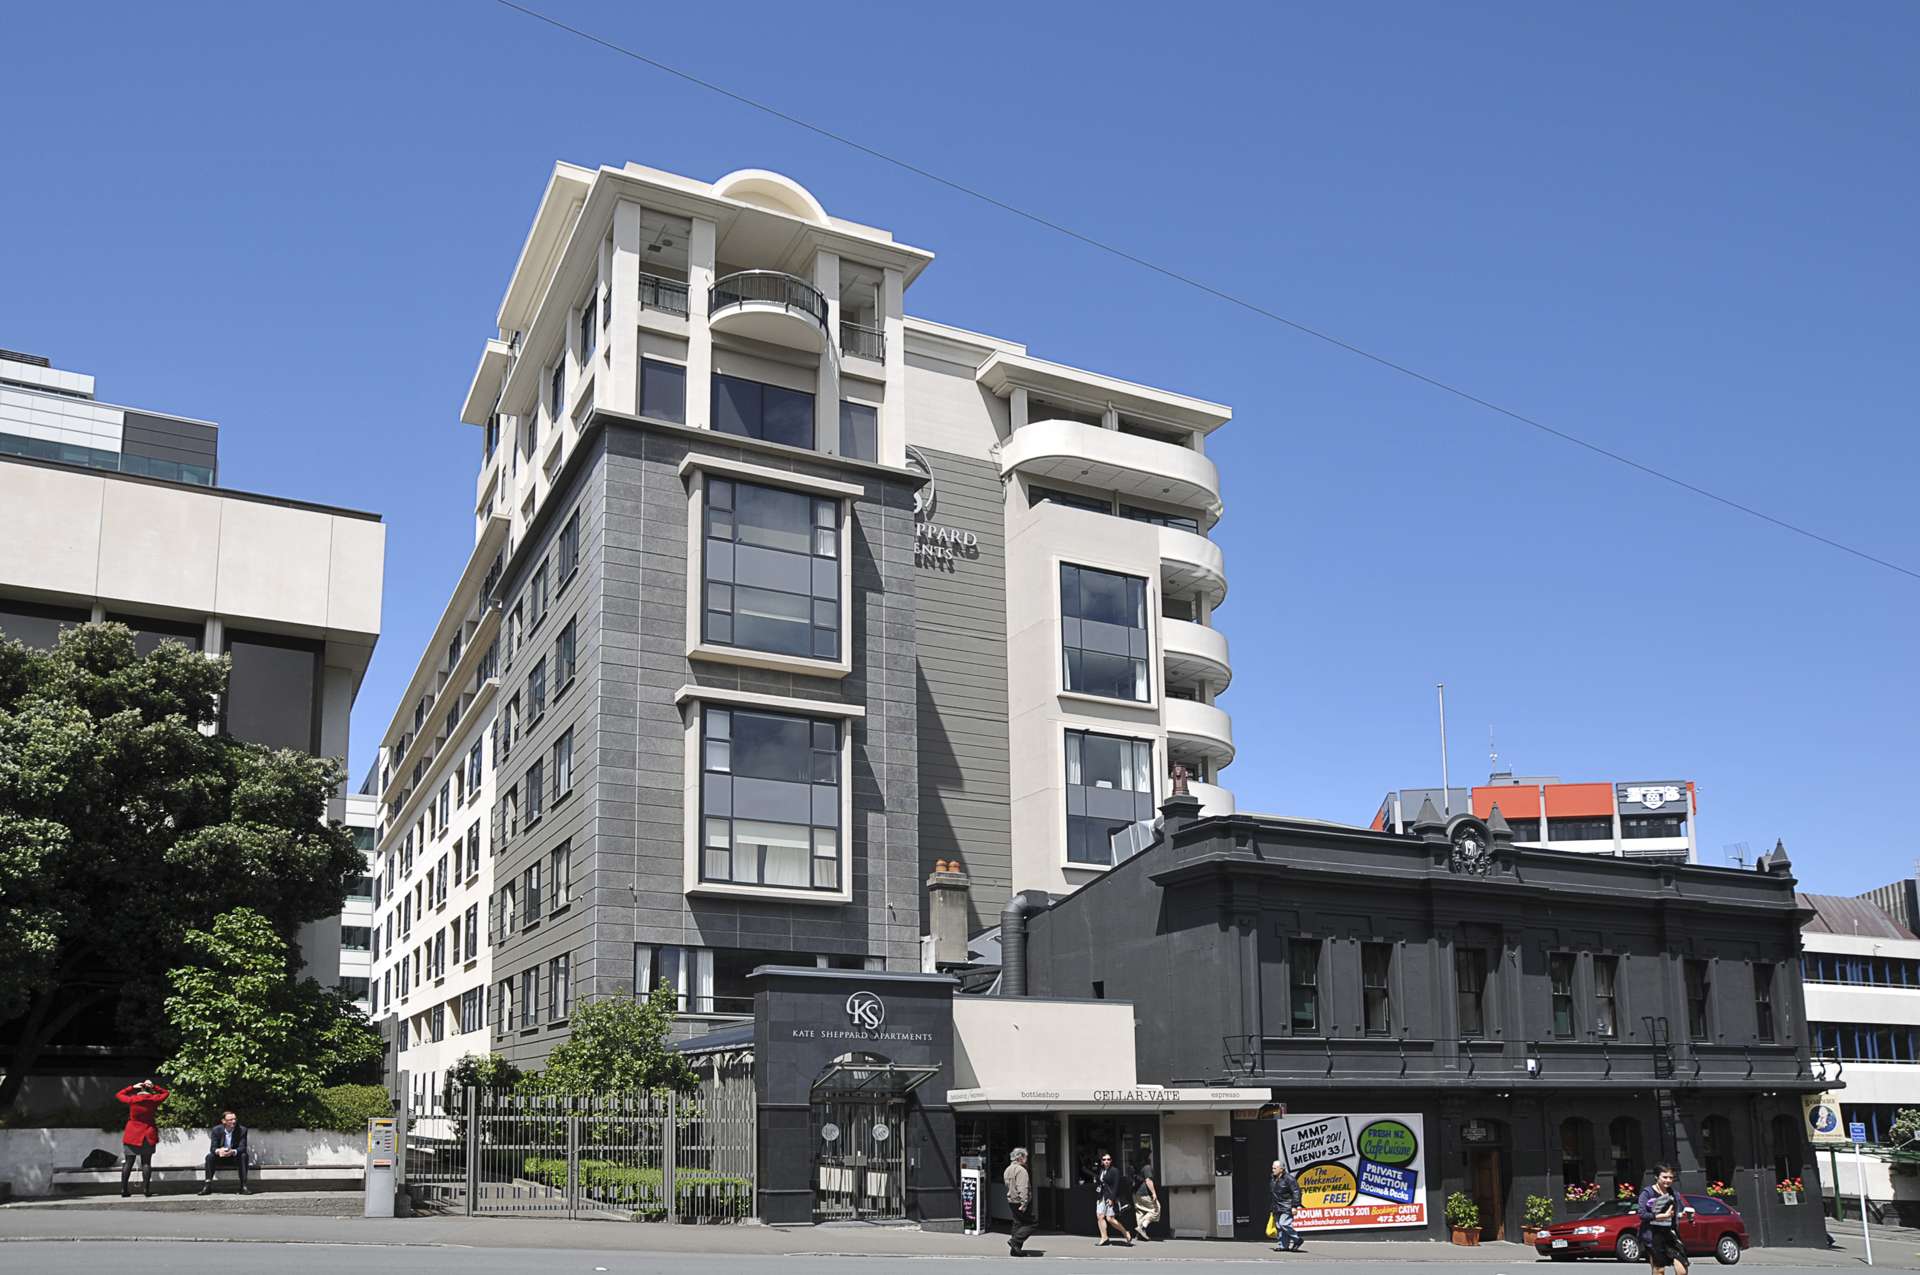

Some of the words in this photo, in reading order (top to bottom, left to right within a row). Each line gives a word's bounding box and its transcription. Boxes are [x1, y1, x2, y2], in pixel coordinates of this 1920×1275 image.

[792, 1029, 815, 1038] KATE
[821, 1030, 868, 1039] SHEPPARD
[873, 1031, 933, 1041] APARTMENTS
[1021, 1090, 1060, 1098] bottleshop
[1093, 1090, 1180, 1101] CELLAR-VATE
[1211, 1091, 1240, 1099] espresso
[1297, 1124, 1328, 1140] MMP
[1368, 1129, 1391, 1137] FRESH
[1394, 1130, 1405, 1138] NZ
[1290, 1136, 1325, 1154] ELECTION
[1326, 1131, 1342, 1144] 2011
[1366, 1163, 1403, 1180] PRIVATE
[1362, 1172, 1408, 1191] FUNCTION
[1323, 1192, 1351, 1204] FREE!
[1294, 1208, 1322, 1219] ADIUM
[1324, 1207, 1354, 1217] EVENTS
[1355, 1207, 1371, 1216] 2011
[1398, 1205, 1420, 1213] CATHY
[1377, 1215, 1394, 1223] 472
